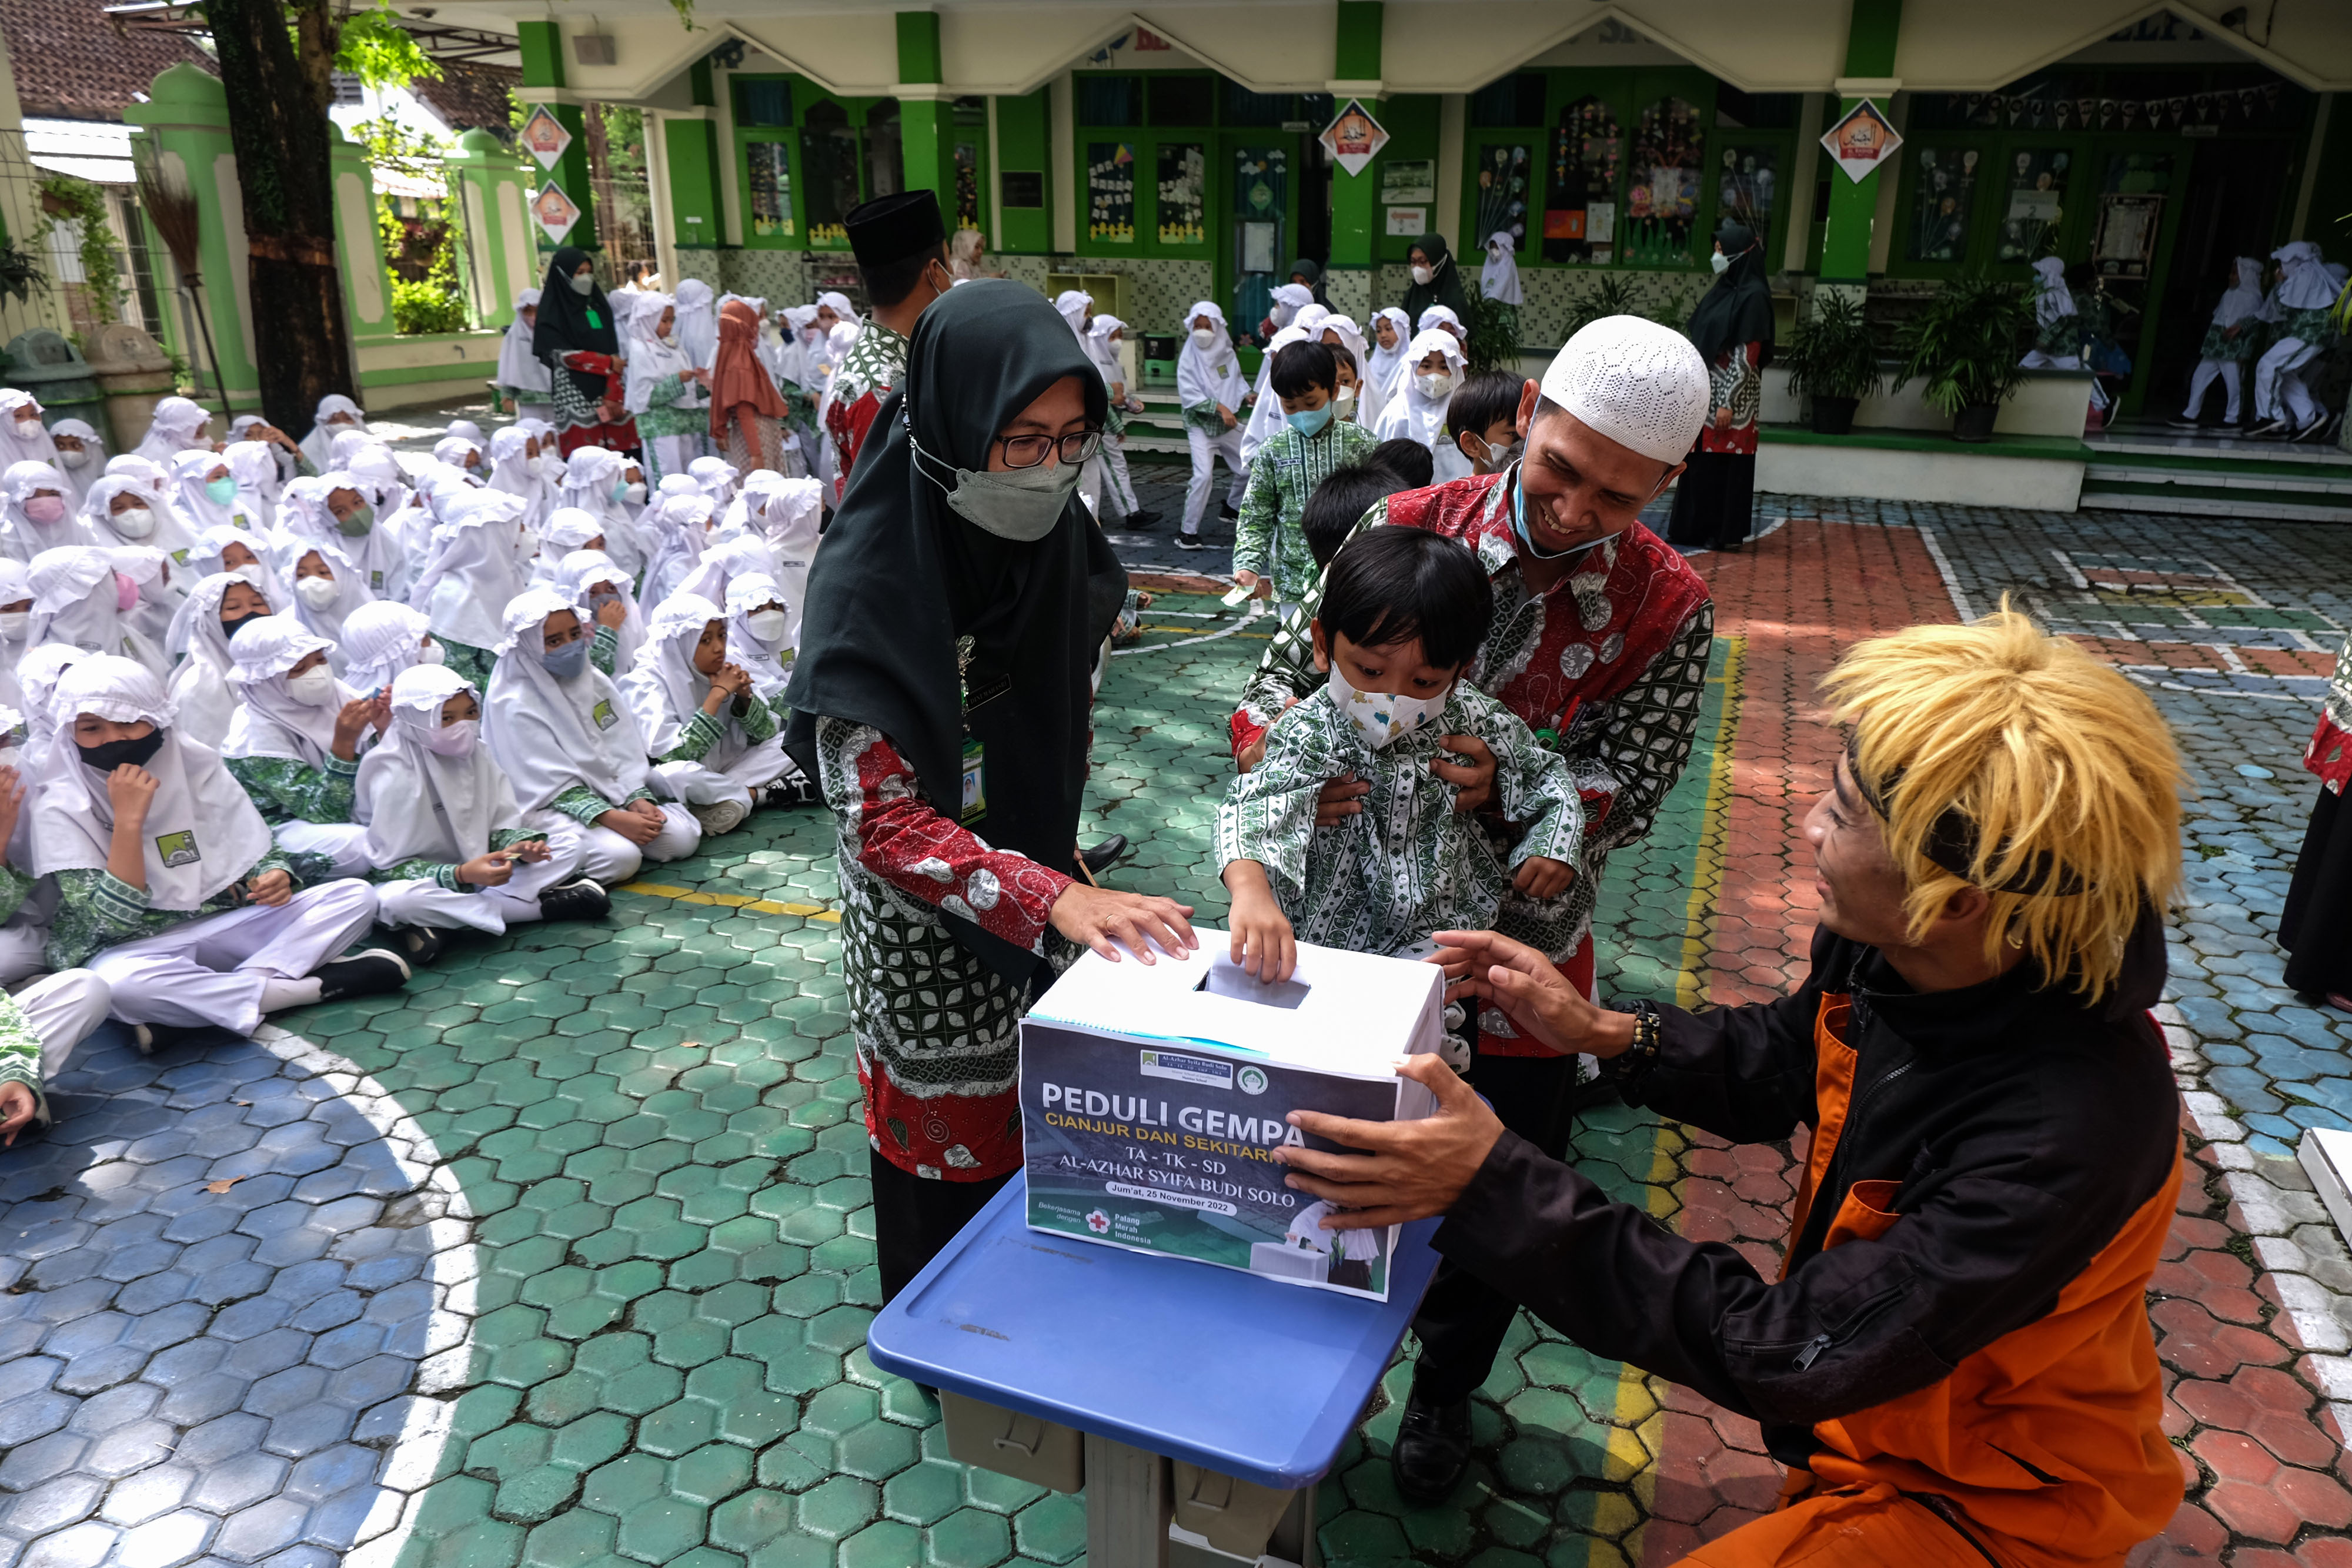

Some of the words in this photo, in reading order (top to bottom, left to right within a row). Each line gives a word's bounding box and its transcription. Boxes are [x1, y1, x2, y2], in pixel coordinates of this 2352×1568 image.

[2028, 205, 2037, 217] 2
[1161, 1055, 1187, 1064] Al-Azhar
[1187, 1059, 1201, 1067] Syifa
[1043, 1082, 1168, 1126] PEDULI
[1178, 1106, 1305, 1148] GEMPA
[1045, 1112, 1130, 1138] CIANJUR
[1135, 1127, 1178, 1145] DAN
[1184, 1135, 1291, 1166] SEKITAR
[1125, 1146, 1147, 1162] TA
[1162, 1152, 1186, 1169] TK
[1202, 1159, 1227, 1175] SD
[1060, 1155, 1144, 1181] AL-AZHAR
[1148, 1169, 1196, 1189] SYIFA
[1200, 1178, 1243, 1199] BUDI
[1248, 1188, 1295, 1208] SOLO
[1147, 1189, 1157, 1198] 25
[1160, 1192, 1205, 1206] November
[1207, 1201, 1228, 1212] 2022
[1038, 1202, 1081, 1216] Bekerjasama
[1056, 1213, 1081, 1223] dengan
[1115, 1213, 1140, 1225] Palang
[1115, 1223, 1138, 1233] Merah
[1115, 1231, 1151, 1245] Indonesia
